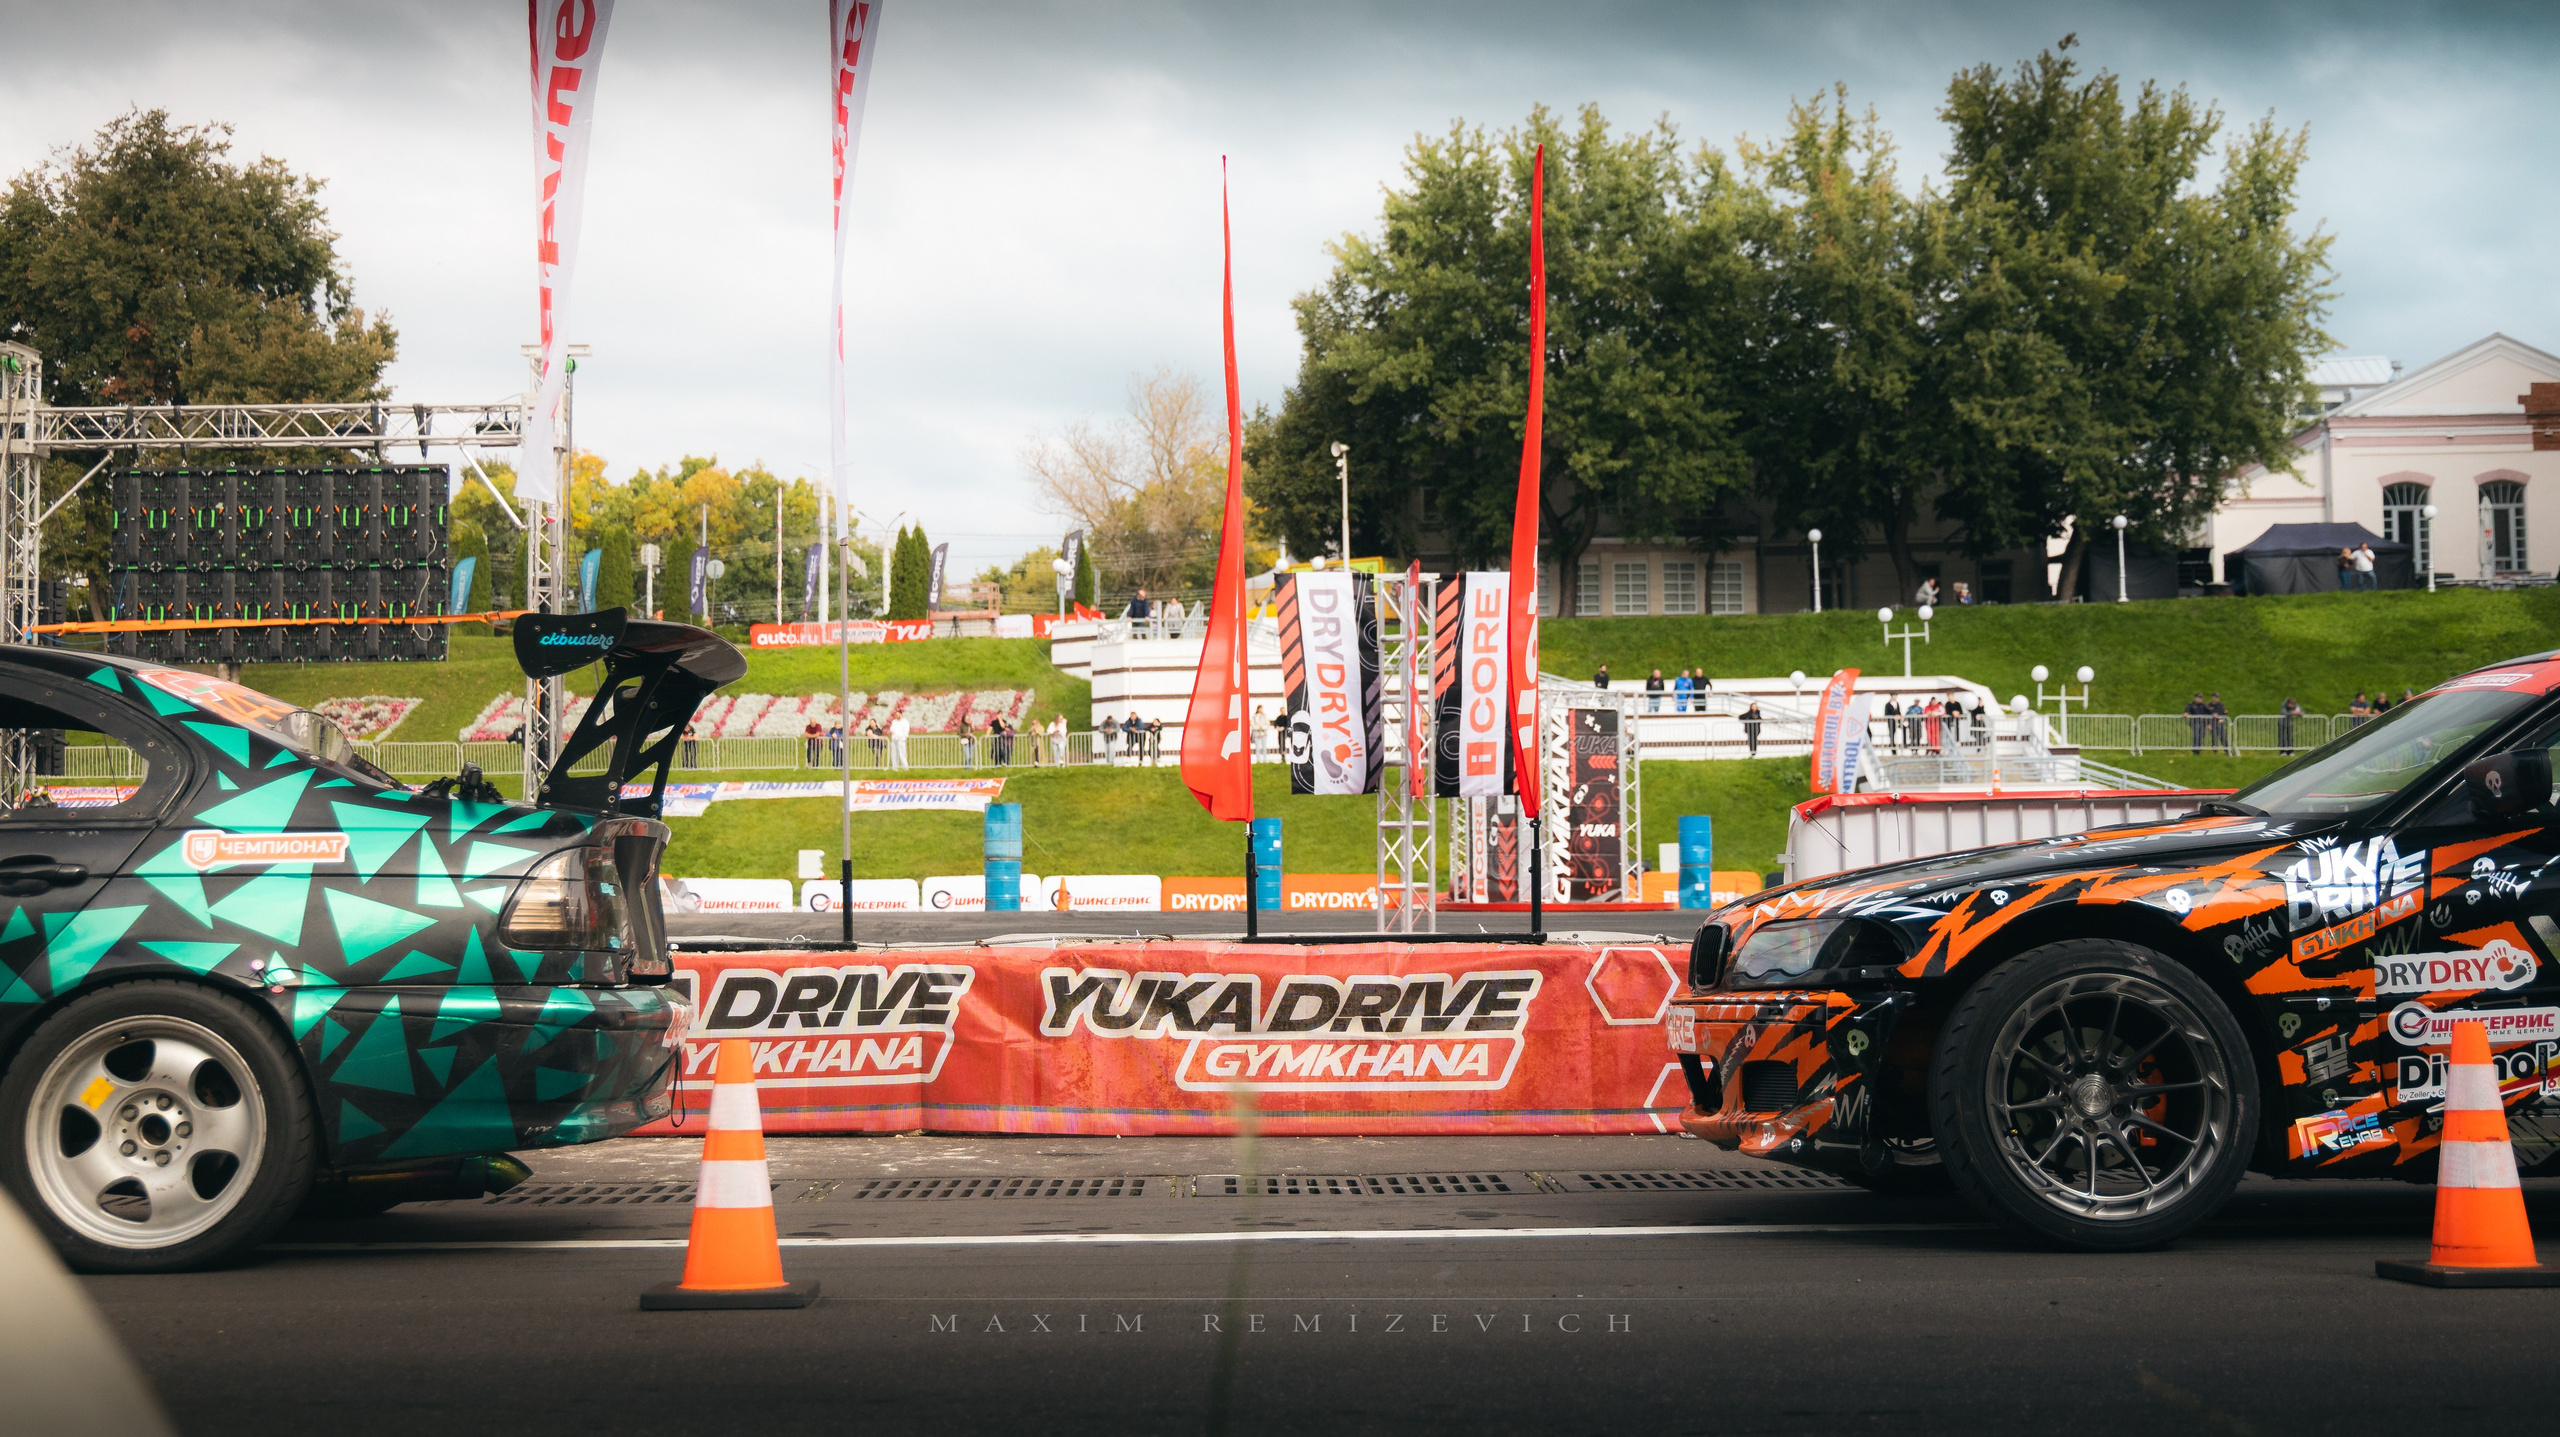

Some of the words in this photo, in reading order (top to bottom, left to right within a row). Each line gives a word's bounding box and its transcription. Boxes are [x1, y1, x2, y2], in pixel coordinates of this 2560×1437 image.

[540, 632, 615, 650] ckbusters
[757, 632, 819, 646] auto.ru
[1308, 588, 1351, 738] DRYDRY
[1574, 734, 1619, 755] YUKA
[1552, 707, 1571, 904] GYMKHANA
[1579, 824, 1616, 838] YUKA
[220, 839, 342, 855] ЧЕМПИОНАТ
[703, 900, 783, 909] ШИНСЕРВИС
[832, 900, 909, 910] ШНСЕРВИС
[1074, 896, 1151, 906] ШИНСЕРВИС
[2298, 893, 2417, 956] GYMKHNA
[2375, 957, 2490, 987] DRYDRY
[705, 971, 968, 1030] DRIVE
[1047, 975, 1253, 1032] YUKA
[1274, 978, 1537, 1034] DRIVE
[2431, 1013, 2556, 1032] ШЕРВИС
[685, 1036, 923, 1075] YKHANA
[1205, 1043, 1489, 1077] GYMKHANA
